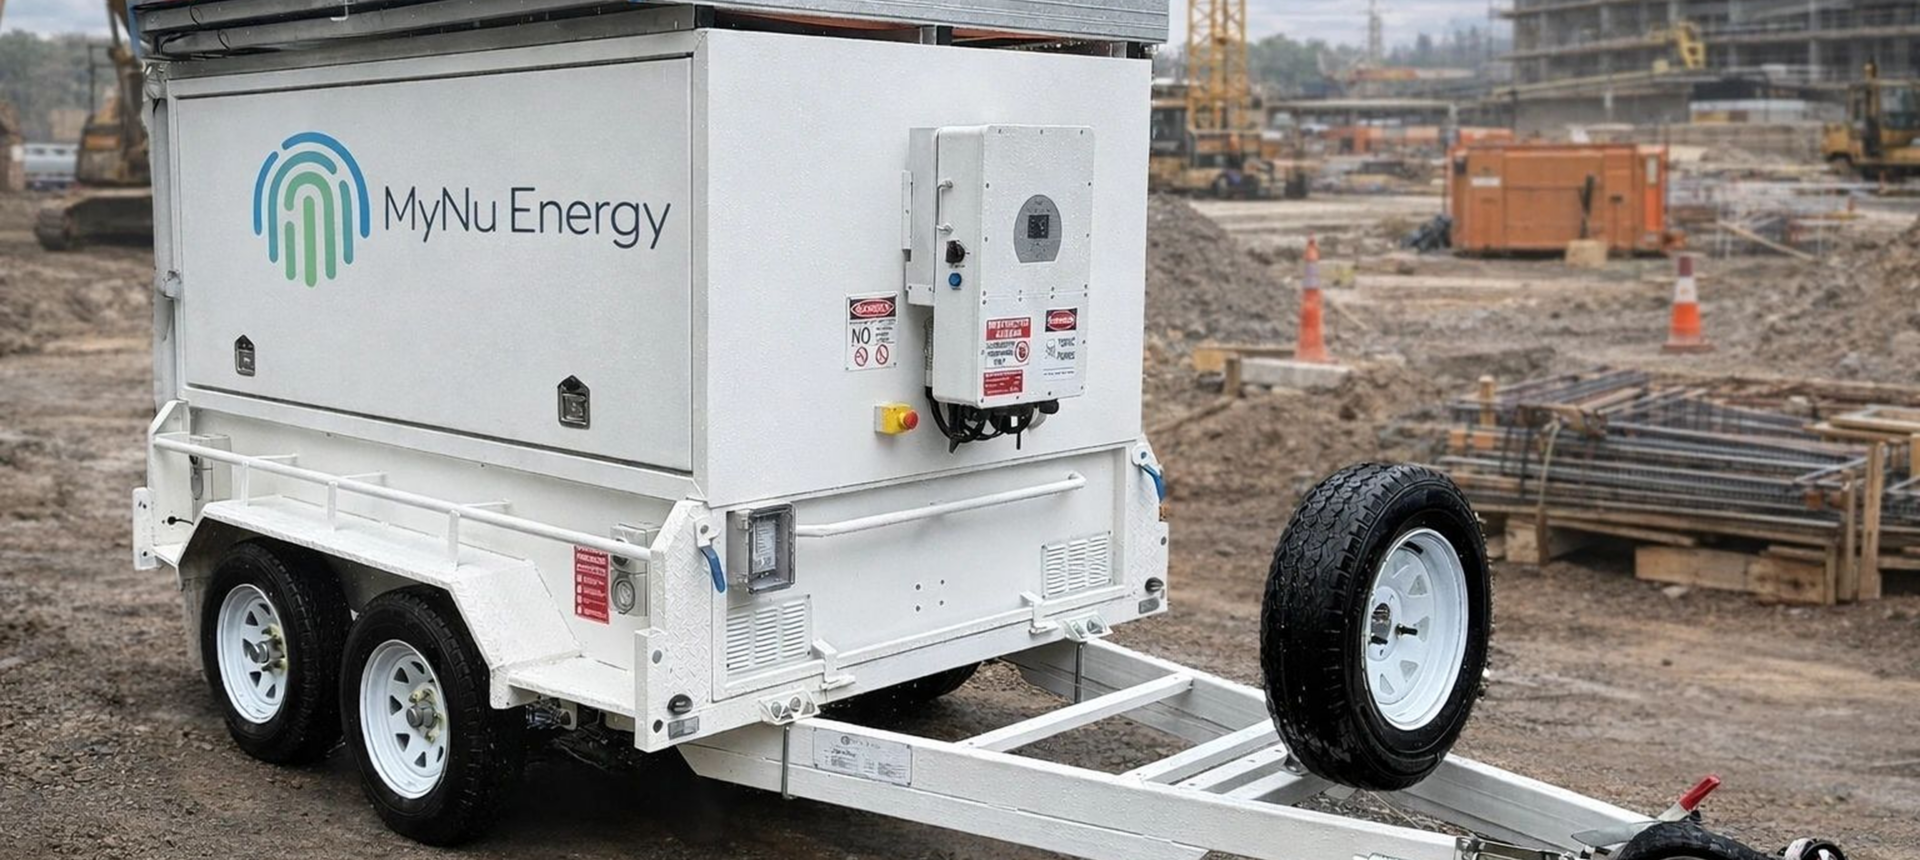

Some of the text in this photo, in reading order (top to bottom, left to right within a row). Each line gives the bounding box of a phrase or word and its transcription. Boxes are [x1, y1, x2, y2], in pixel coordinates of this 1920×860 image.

[384, 186, 671, 249] MyNu Energy
[851, 326, 871, 344] NO
